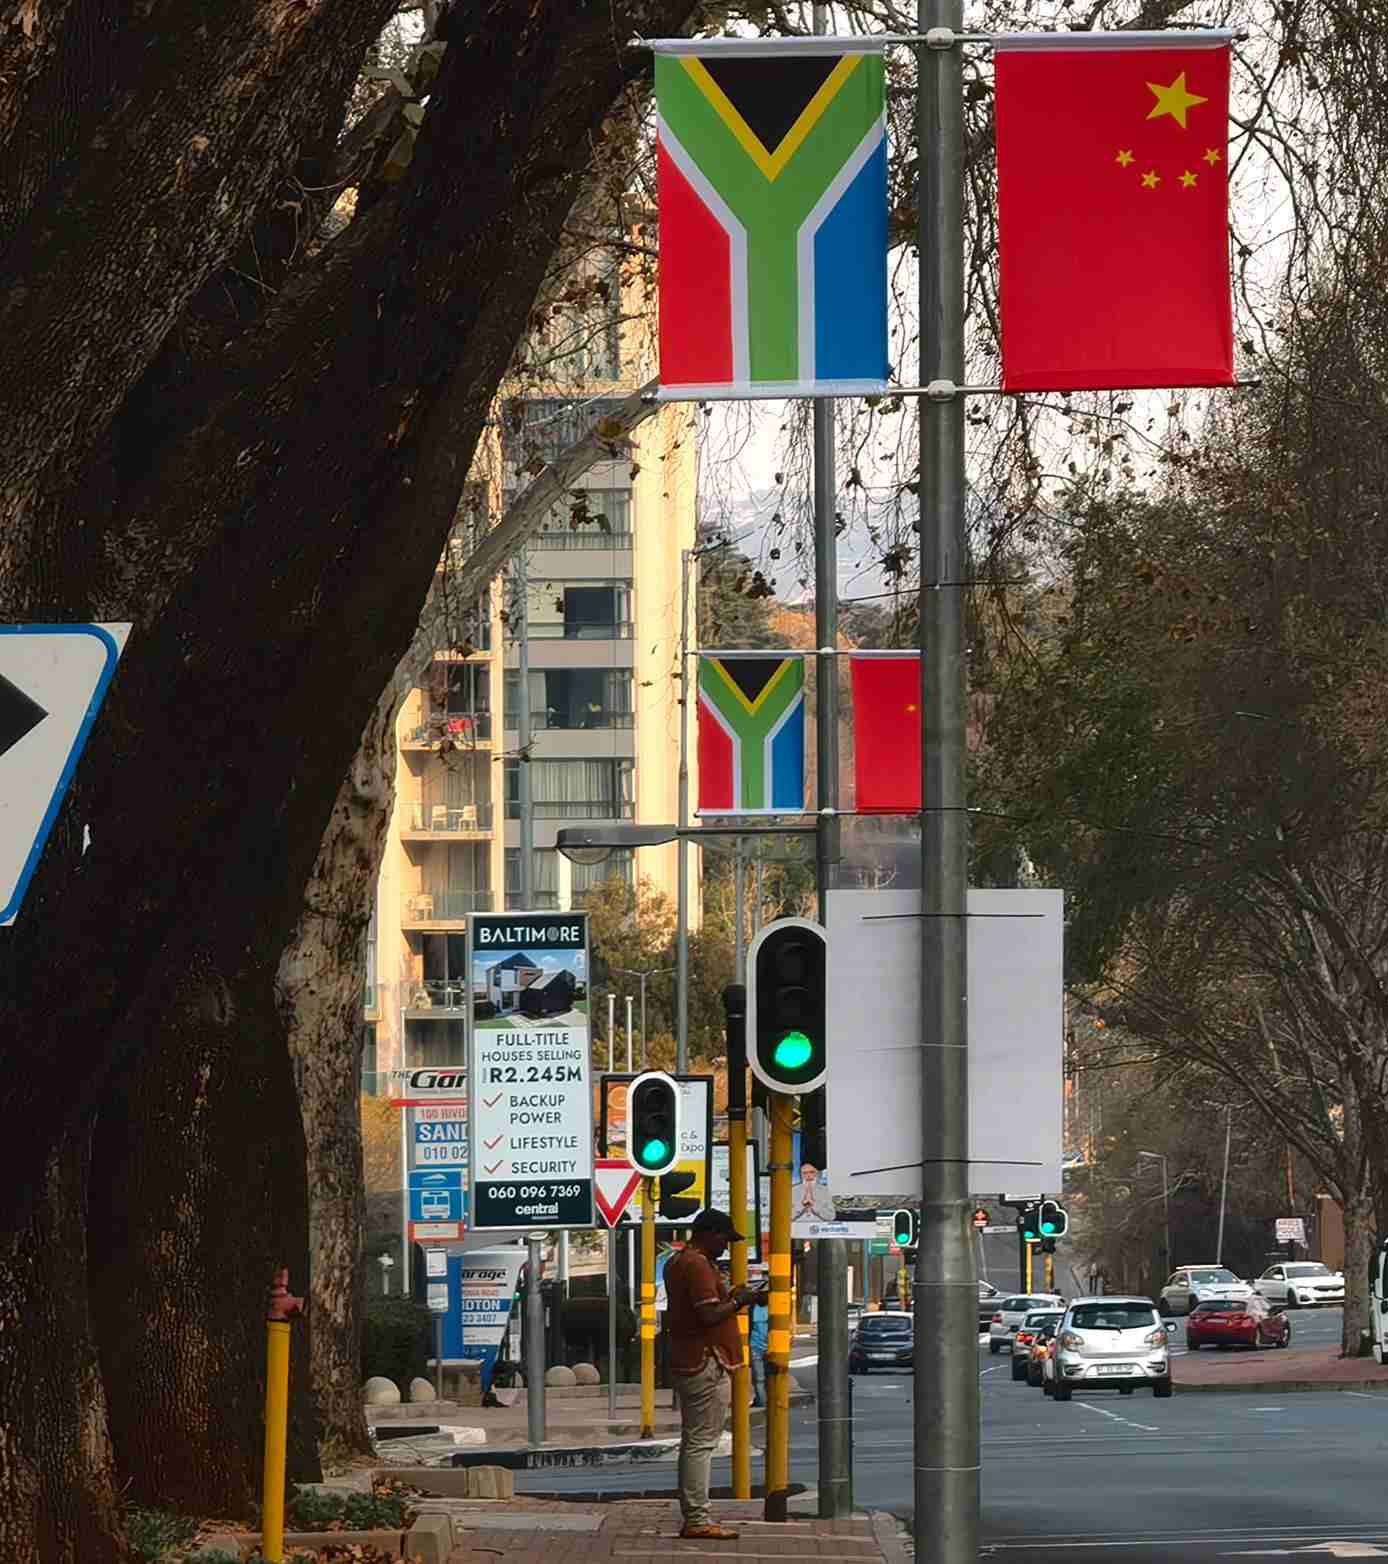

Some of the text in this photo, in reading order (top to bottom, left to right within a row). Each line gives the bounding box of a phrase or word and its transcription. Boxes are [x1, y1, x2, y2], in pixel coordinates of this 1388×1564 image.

[497, 1033, 569, 1046] FULL-TITLE
[482, 1050, 582, 1062] HOUSES SELLING
[490, 1066, 582, 1083] R2.245M
[510, 1095, 565, 1107] BACKUP
[510, 1112, 562, 1124] POWER
[510, 1136, 577, 1149] LIFESTYLE
[423, 1146, 448, 1160] 010
[511, 1161, 576, 1174] SECURITY
[488, 1185, 581, 1198] 060 096 7369
[515, 1202, 559, 1215] central
